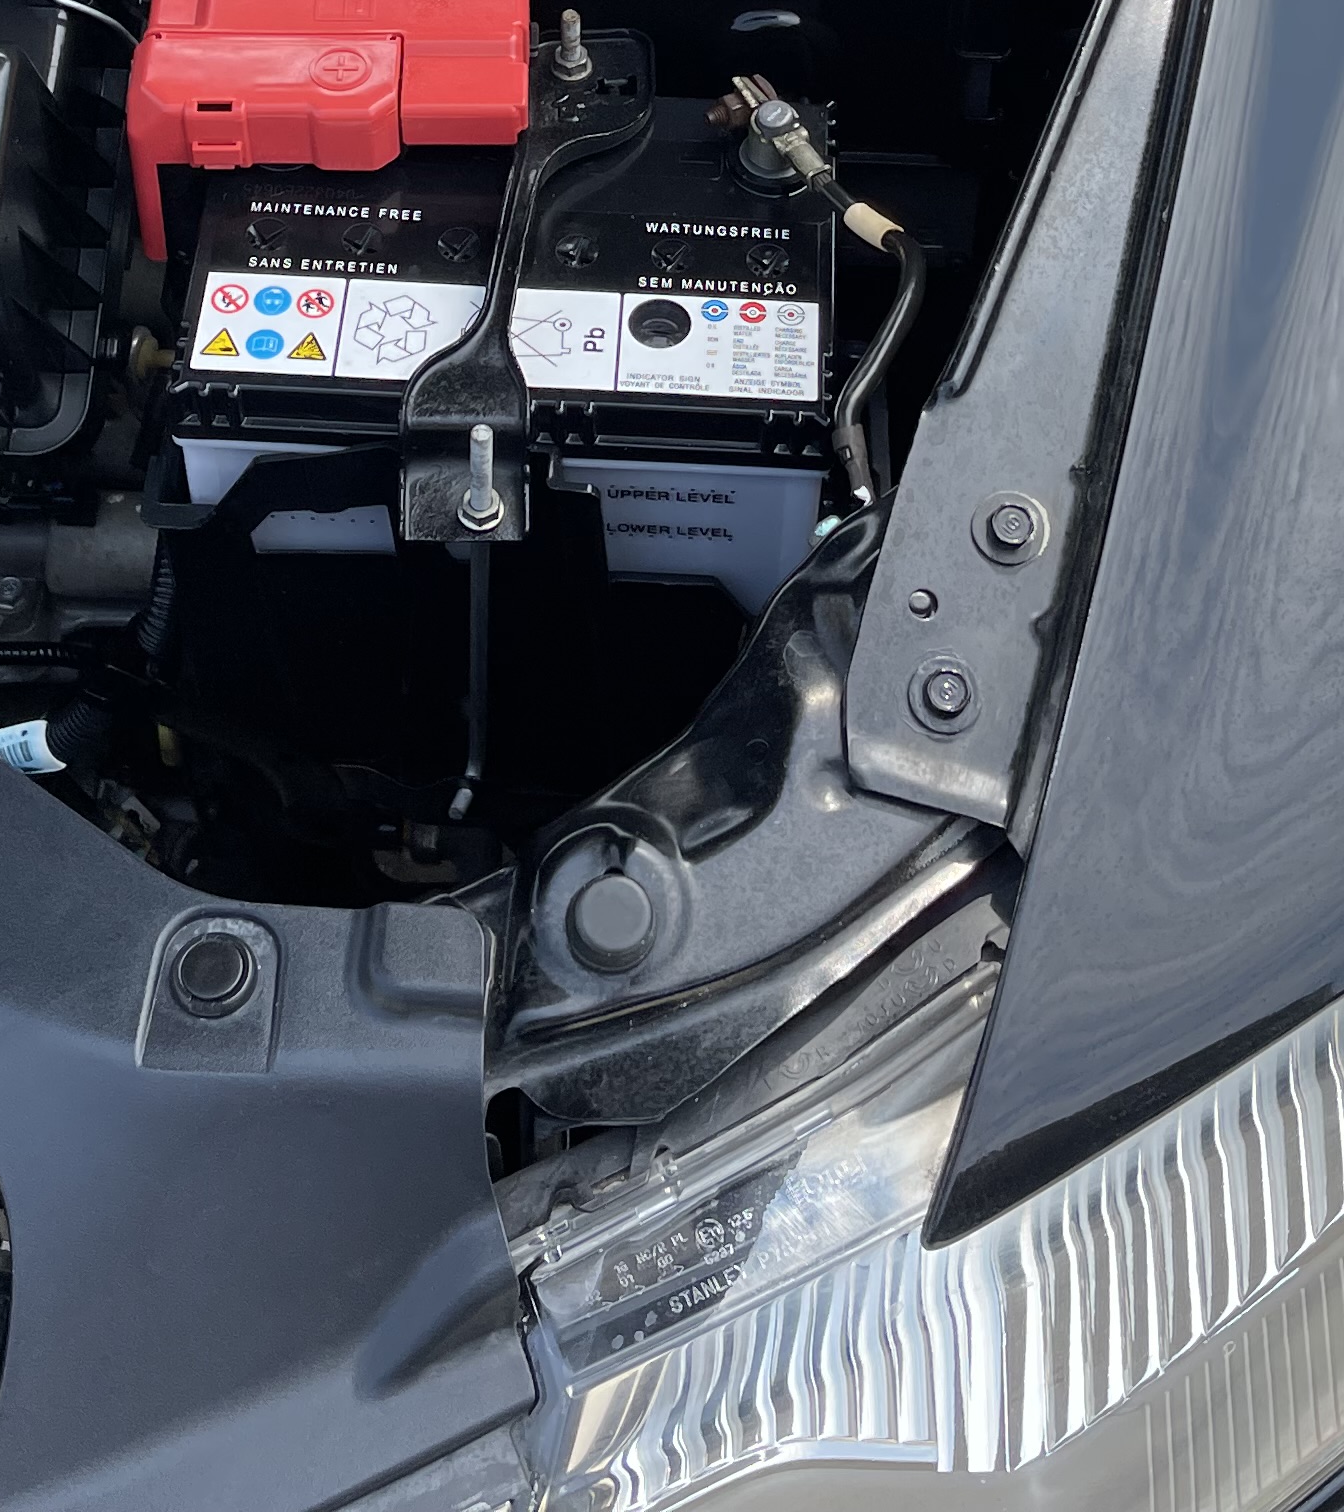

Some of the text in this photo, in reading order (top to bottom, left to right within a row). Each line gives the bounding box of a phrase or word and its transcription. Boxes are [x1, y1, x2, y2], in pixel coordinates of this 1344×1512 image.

[250, 201, 422, 221] MAINTENANCE FREE
[645, 222, 790, 240] WARTUNGSFREIE
[248, 256, 398, 274] SANS ENTRETIEN
[638, 276, 797, 296] SEM MANUTENÇÃO
[583, 327, 605, 352] Pb
[620, 381, 650, 389] VOYANT
[669, 381, 710, 391] CONTRÔLE
[626, 372, 700, 383] INDICATOR SIGN
[734, 378, 802, 388] ANZEIGE SYMBOL
[729, 386, 805, 396] SINAL INDICADOR
[607, 489, 735, 504] UPPER LEVEL
[606, 522, 733, 538] LOWER LEVEL
[668, 1260, 747, 1314] STANLEY
